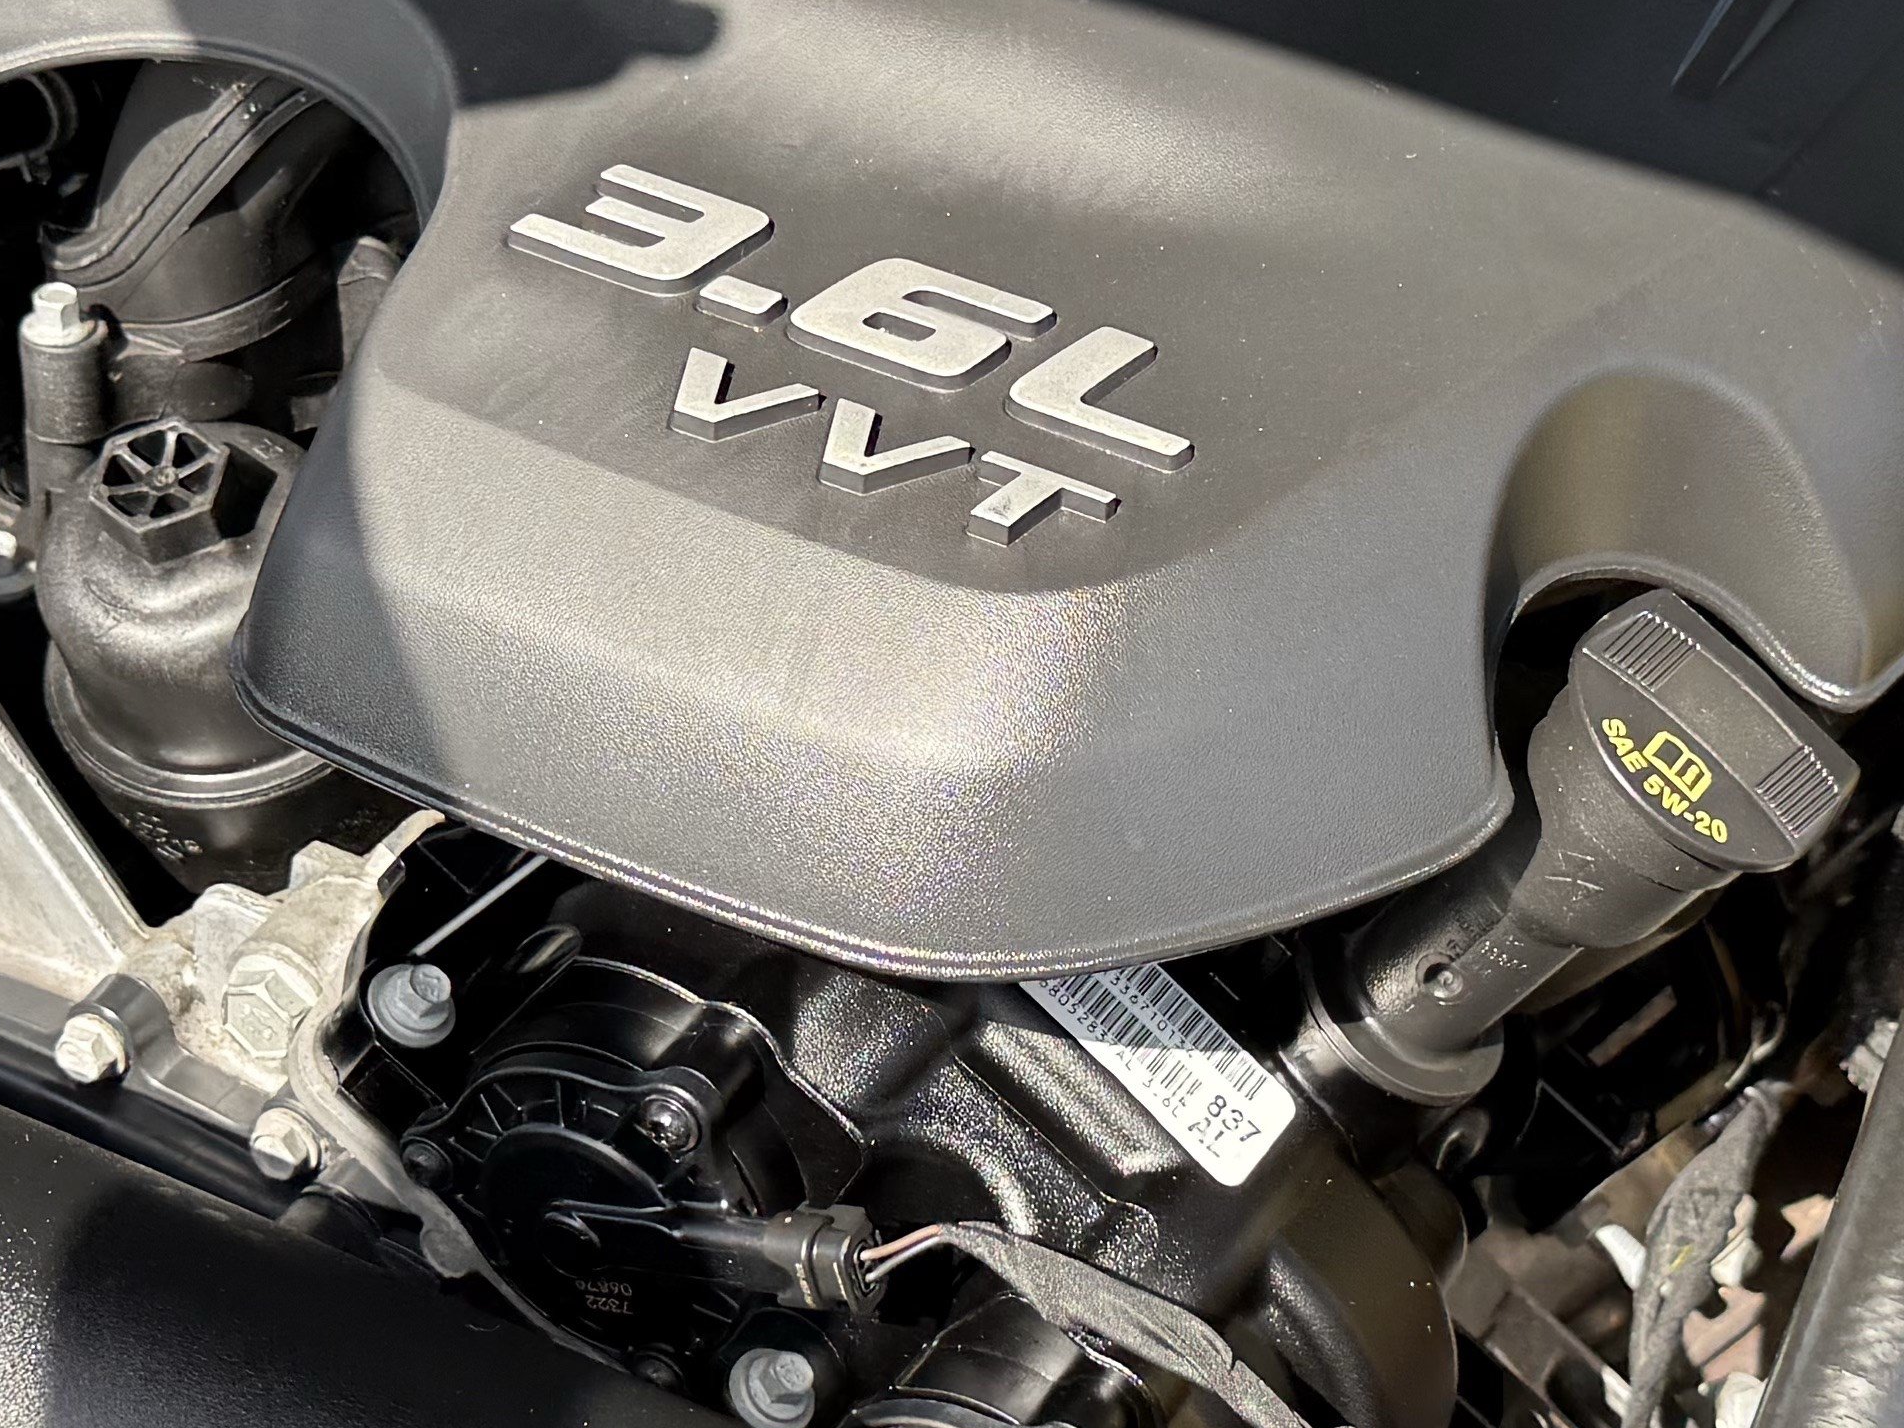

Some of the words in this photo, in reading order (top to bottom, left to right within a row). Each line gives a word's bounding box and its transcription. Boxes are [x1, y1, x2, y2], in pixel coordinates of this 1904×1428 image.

[506, 163, 1196, 473] 3.6L
[667, 346, 1123, 548] VVT
[1601, 718, 1648, 773] SAE
[1642, 778, 1728, 844] 5W-20
[1188, 1119, 1223, 1159] AL
[1206, 1093, 1263, 1143] 837
